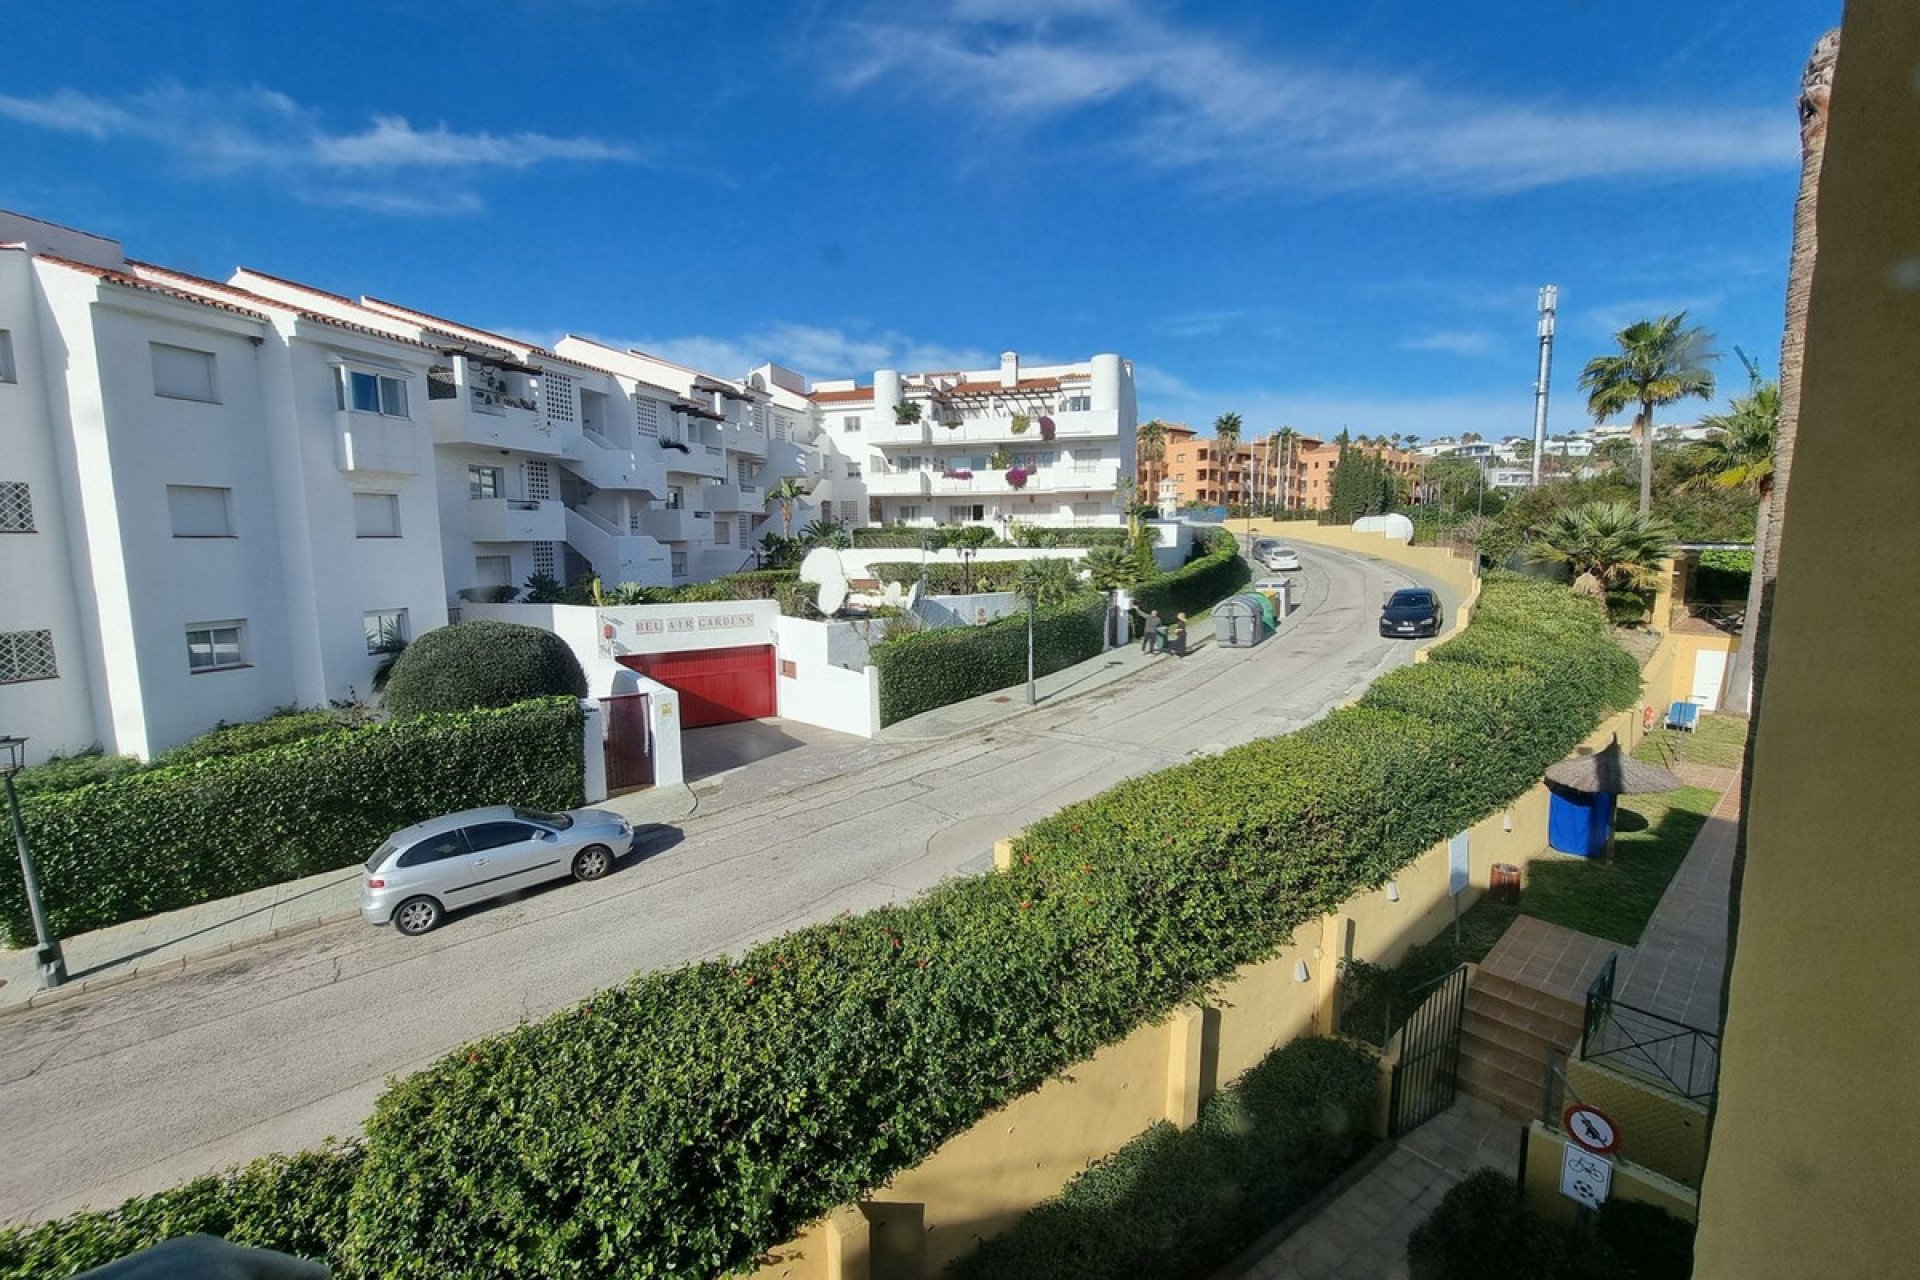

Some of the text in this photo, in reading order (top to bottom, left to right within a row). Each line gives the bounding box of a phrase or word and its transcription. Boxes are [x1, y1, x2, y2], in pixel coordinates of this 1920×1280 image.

[636, 615, 754, 633] BEL AIR GARDENS
